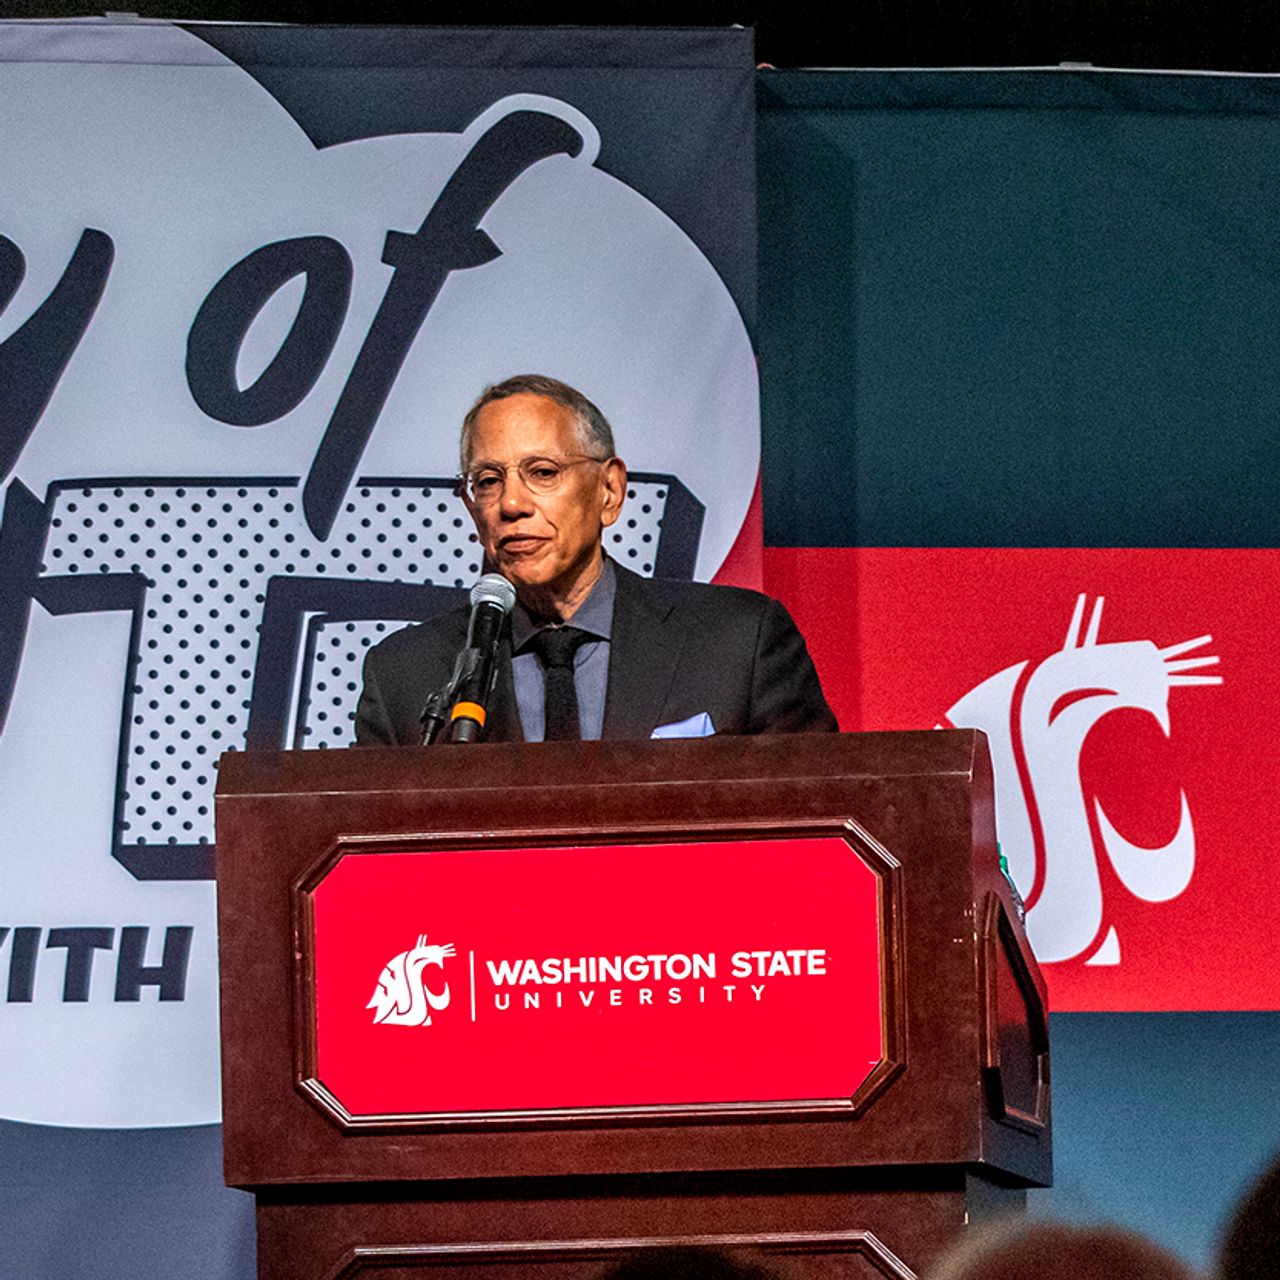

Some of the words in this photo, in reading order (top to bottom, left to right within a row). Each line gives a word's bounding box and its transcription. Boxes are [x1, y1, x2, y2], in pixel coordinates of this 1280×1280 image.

[185, 109, 584, 542] of
[0, 926, 194, 1003] ITH
[486, 954, 716, 985] WASHINGTON
[732, 949, 827, 977] STATE
[495, 984, 765, 1011] UNIVERSITY
